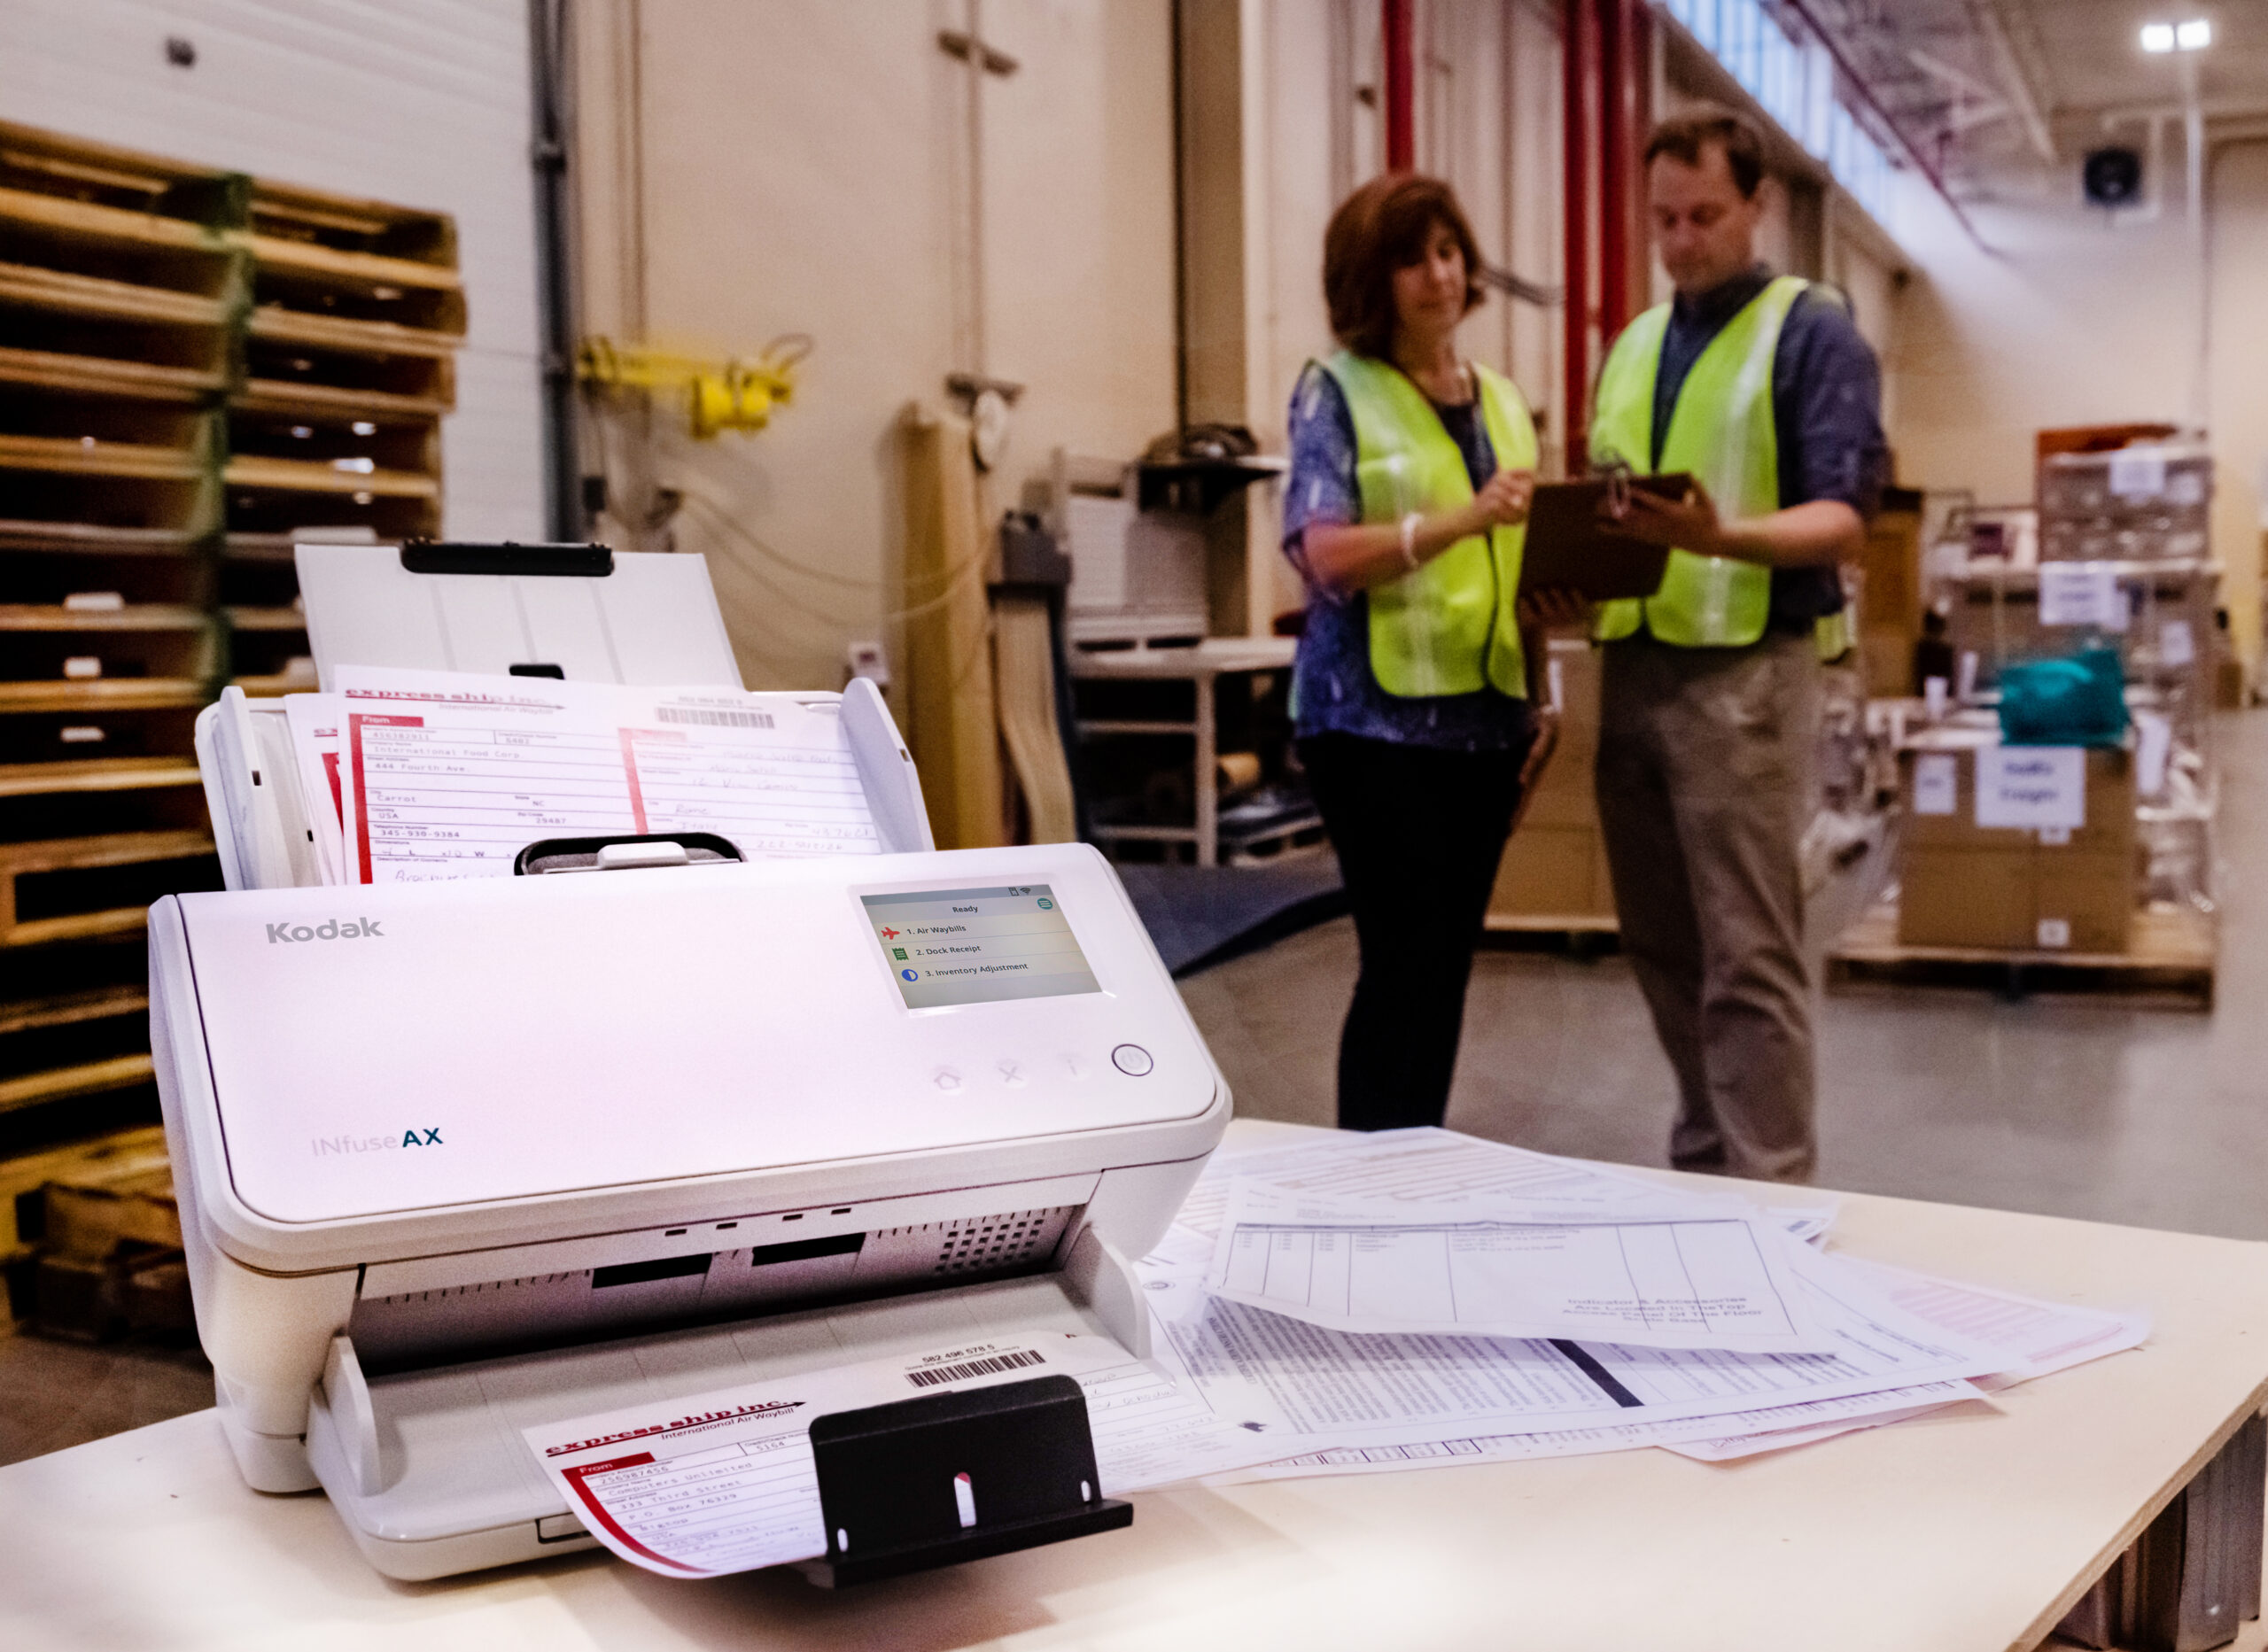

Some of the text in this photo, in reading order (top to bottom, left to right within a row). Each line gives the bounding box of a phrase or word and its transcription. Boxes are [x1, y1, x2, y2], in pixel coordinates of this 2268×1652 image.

[346, 688, 446, 700] express
[451, 692, 503, 703] ship
[439, 702, 501, 712] International
[361, 715, 391, 725] From
[375, 746, 456, 756] International
[377, 794, 416, 803] Carrot
[381, 829, 461, 839] 345-930-9384
[952, 904, 978, 914] Ready
[266, 917, 384, 943] Kodak
[930, 924, 967, 935] Waybills
[926, 946, 949, 955] Dock
[950, 944, 982, 955] Receipt
[936, 966, 977, 977] Inventory
[980, 962, 1029, 973] Adjustment
[922, 1354, 942, 1363] 582
[966, 1346, 986, 1355] 578
[545, 1400, 788, 1454] express ship inc.
[661, 1418, 735, 1440] International
[752, 1408, 795, 1420] Waybill
[579, 1463, 614, 1473] From
[609, 1462, 752, 1496] Computers Unlimited
[621, 1479, 742, 1510] 333 Third Street
